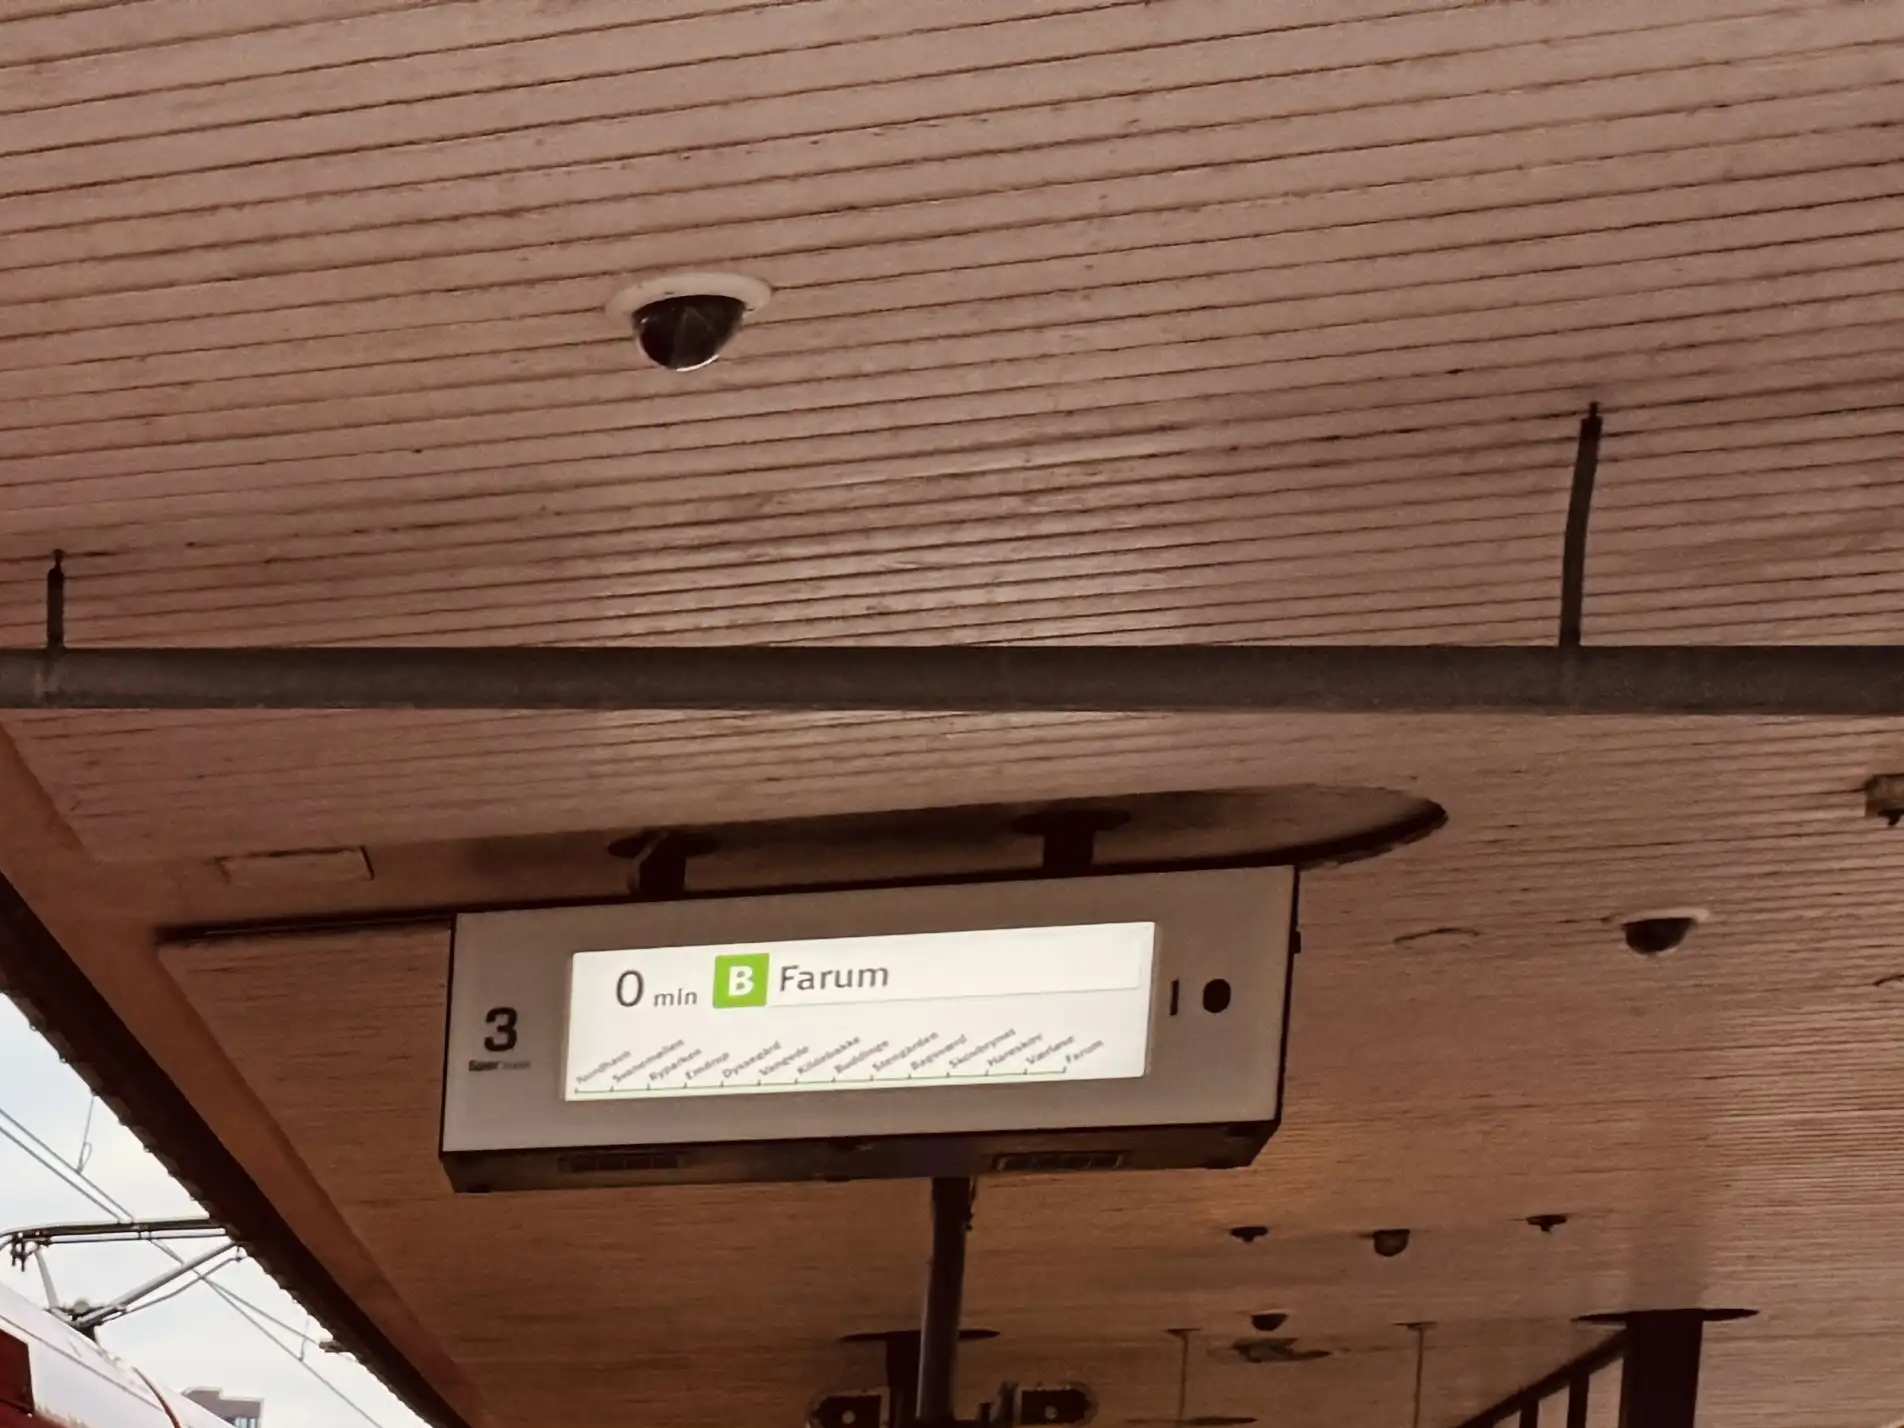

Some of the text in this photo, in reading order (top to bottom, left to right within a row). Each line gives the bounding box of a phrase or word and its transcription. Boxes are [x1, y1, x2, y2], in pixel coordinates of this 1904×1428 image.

[616, 961, 891, 1007] 0 min B Farum
[483, 1007, 519, 1052] 3
